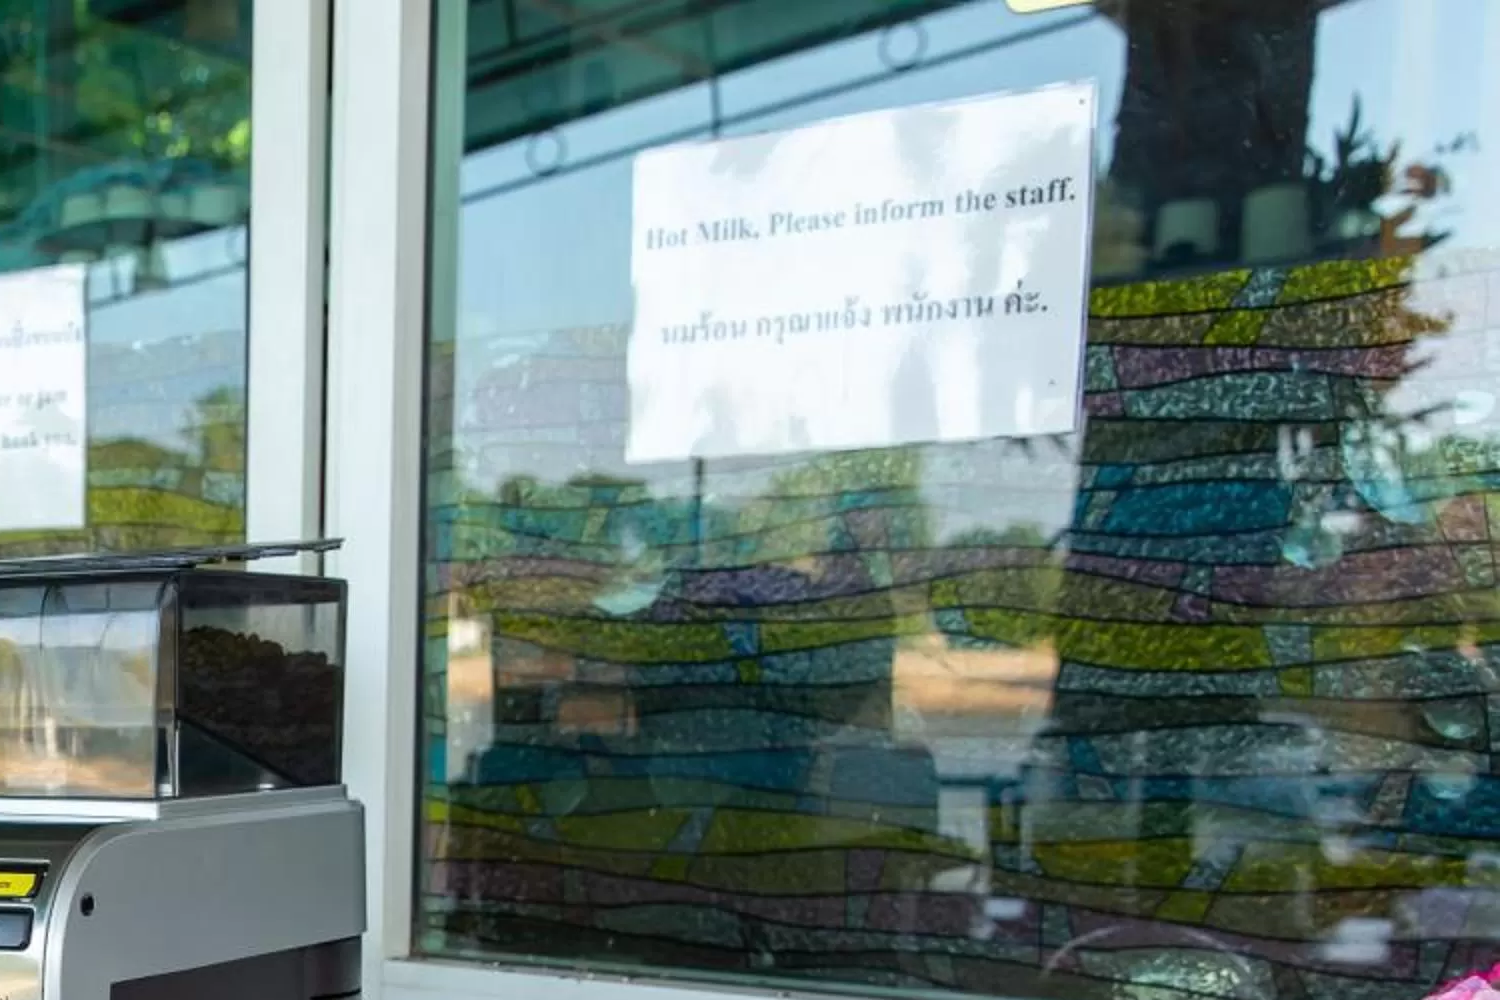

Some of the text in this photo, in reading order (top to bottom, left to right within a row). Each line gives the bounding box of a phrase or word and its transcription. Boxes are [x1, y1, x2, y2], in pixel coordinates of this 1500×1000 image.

[646, 227, 688, 250] Hot
[768, 210, 847, 237] Please
[854, 198, 945, 226] inform
[954, 188, 997, 214] the
[1004, 176, 1077, 209] staff.
